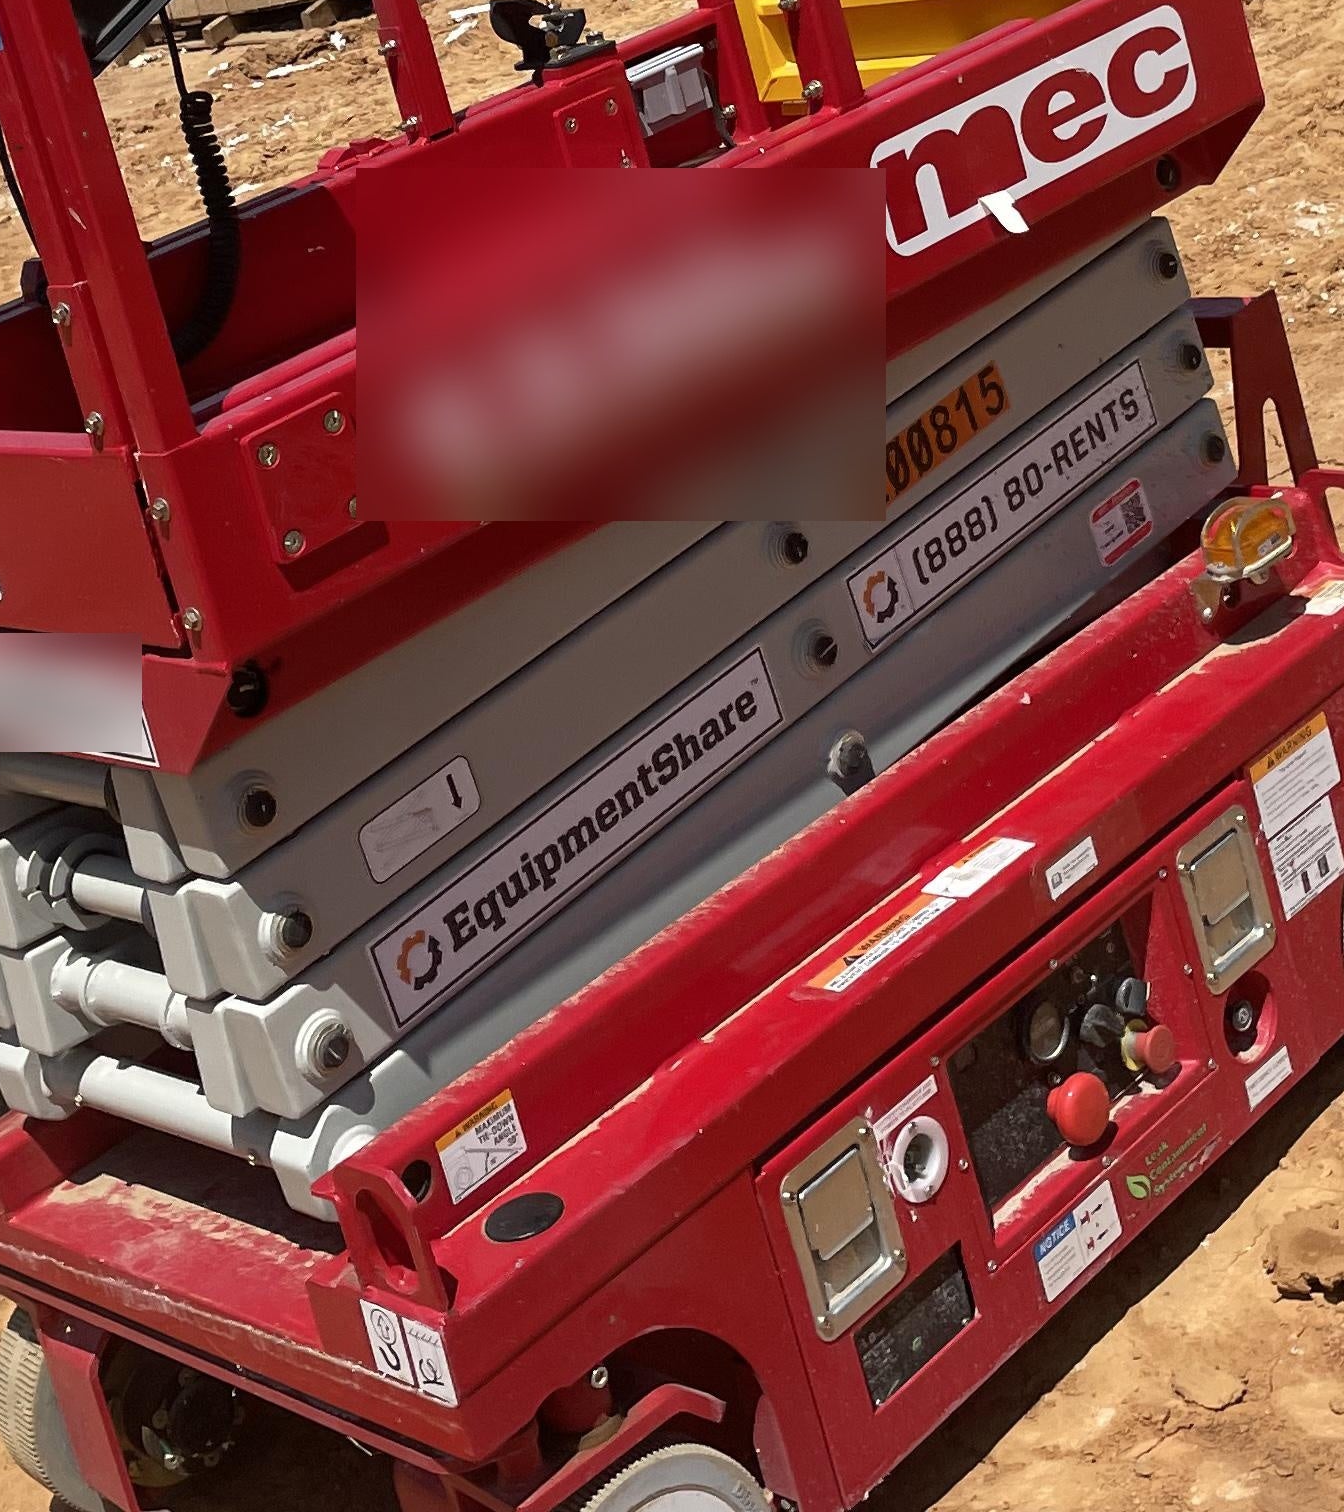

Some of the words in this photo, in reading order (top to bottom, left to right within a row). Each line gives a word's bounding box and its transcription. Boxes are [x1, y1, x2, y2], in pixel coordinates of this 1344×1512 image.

[912, 495, 998, 585] (888)
[442, 690, 758, 953] EquipmentShare
[1039, 1218, 1071, 1255] NOTICE
